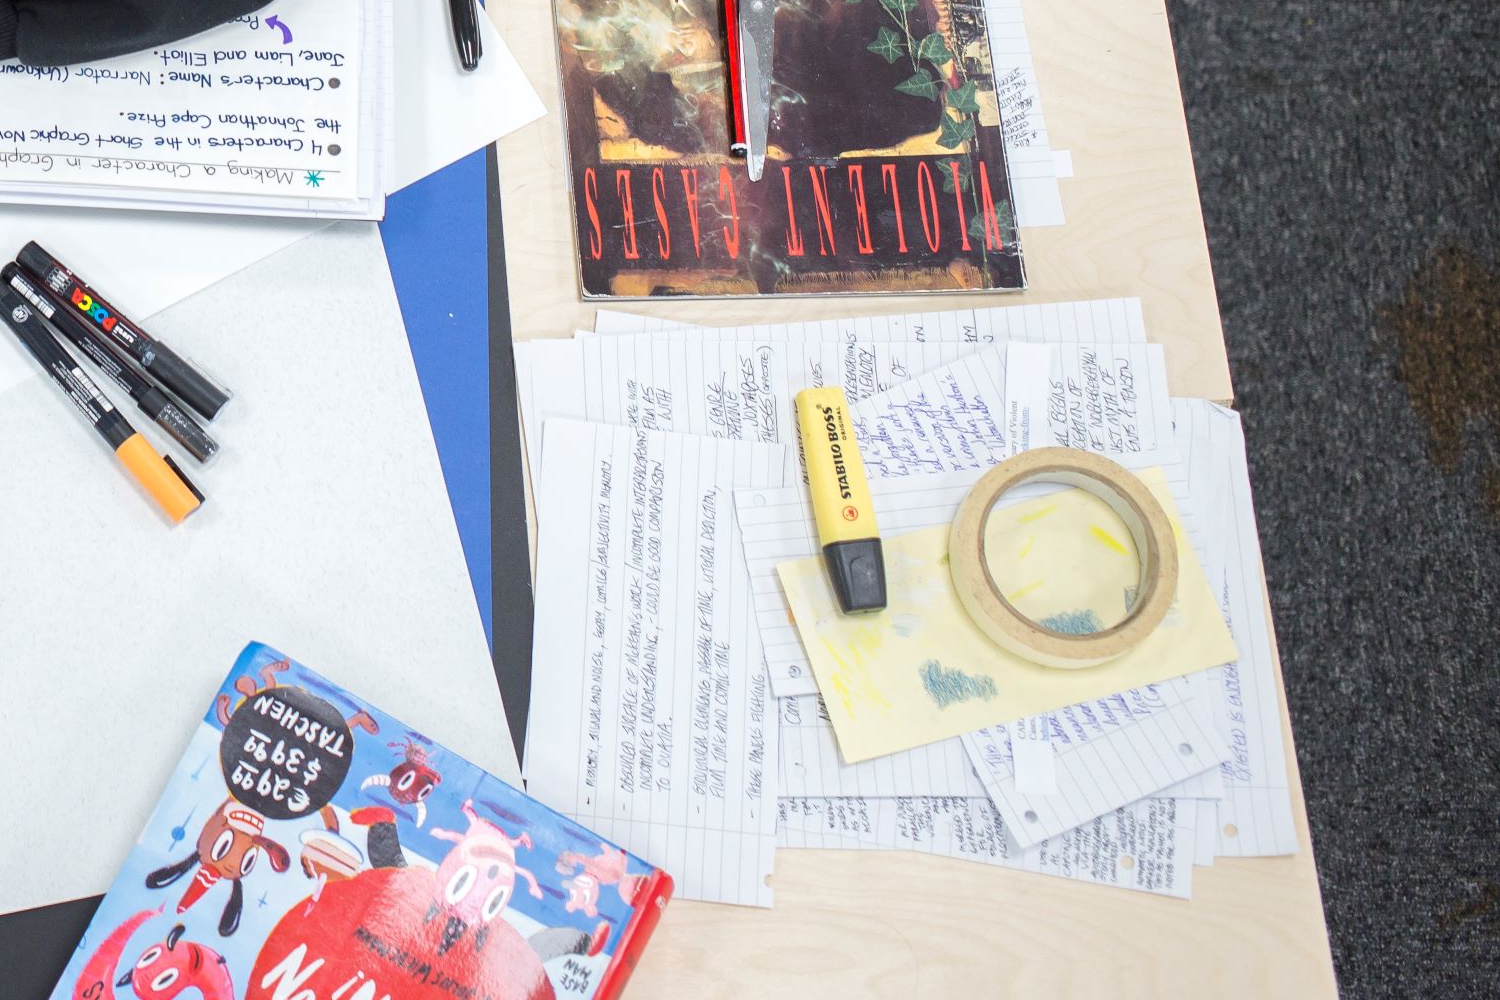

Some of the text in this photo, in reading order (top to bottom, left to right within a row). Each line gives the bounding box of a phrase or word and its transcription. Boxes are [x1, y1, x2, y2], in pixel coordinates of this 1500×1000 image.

[213, 50, 245, 65] and
[252, 50, 293, 66] Liam
[74, 67, 150, 84] Narrator
[219, 74, 324, 90] Character's
[170, 108, 210, 126] Cape
[217, 114, 304, 132] Johnathan
[313, 119, 340, 130] the
[28, 124, 88, 145] Graphic
[97, 133, 142, 148] Short
[153, 135, 182, 148] the
[184, 136, 201, 146] in
[207, 136, 302, 149] Characters
[310, 139, 321, 154] 4
[65, 156, 81, 170] in
[91, 158, 190, 177] Character
[202, 165, 216, 176] a
[226, 159, 292, 184] Making
[583, 161, 1002, 259] VIOLENT CASES
[67, 286, 134, 345] uni POSCA
[836, 405, 846, 440] ORIGINAL
[822, 405, 850, 500] STABILO BOSS
[252, 692, 346, 757] TASCHEN
[563, 958, 592, 980] MAN
